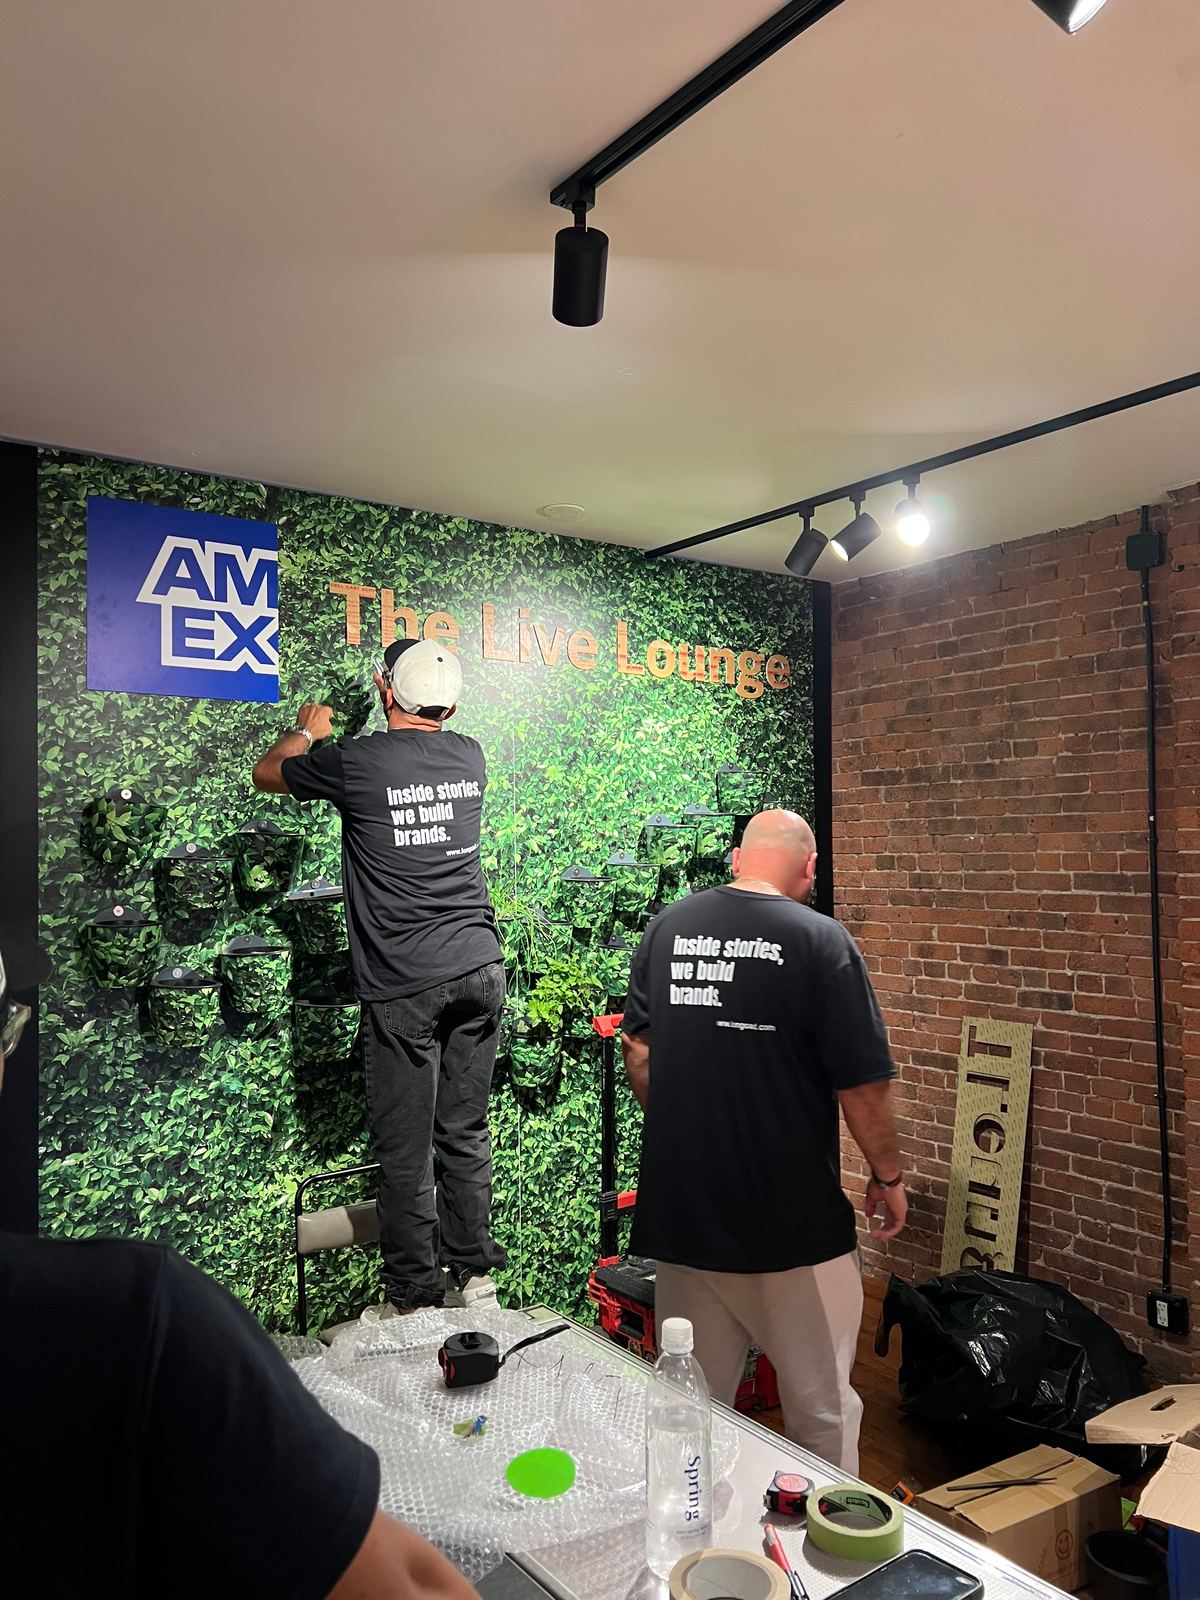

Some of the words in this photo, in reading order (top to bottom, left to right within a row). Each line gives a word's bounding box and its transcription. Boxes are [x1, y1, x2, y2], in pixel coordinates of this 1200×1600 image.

[139, 537, 279, 609] AM
[166, 605, 279, 672] EX
[329, 581, 460, 655] The
[482, 602, 598, 671] Live
[617, 620, 790, 699] Lounge
[386, 784, 435, 806] inside
[436, 780, 481, 800] stories,
[390, 808, 416, 826] we
[418, 802, 454, 824] build
[393, 825, 452, 847] brands.
[673, 935, 721, 957] inside
[723, 938, 785, 966] stories,
[671, 962, 694, 980] we
[696, 960, 736, 982] build
[670, 984, 723, 1007] brands.
[684, 1455, 702, 1521] Spring
